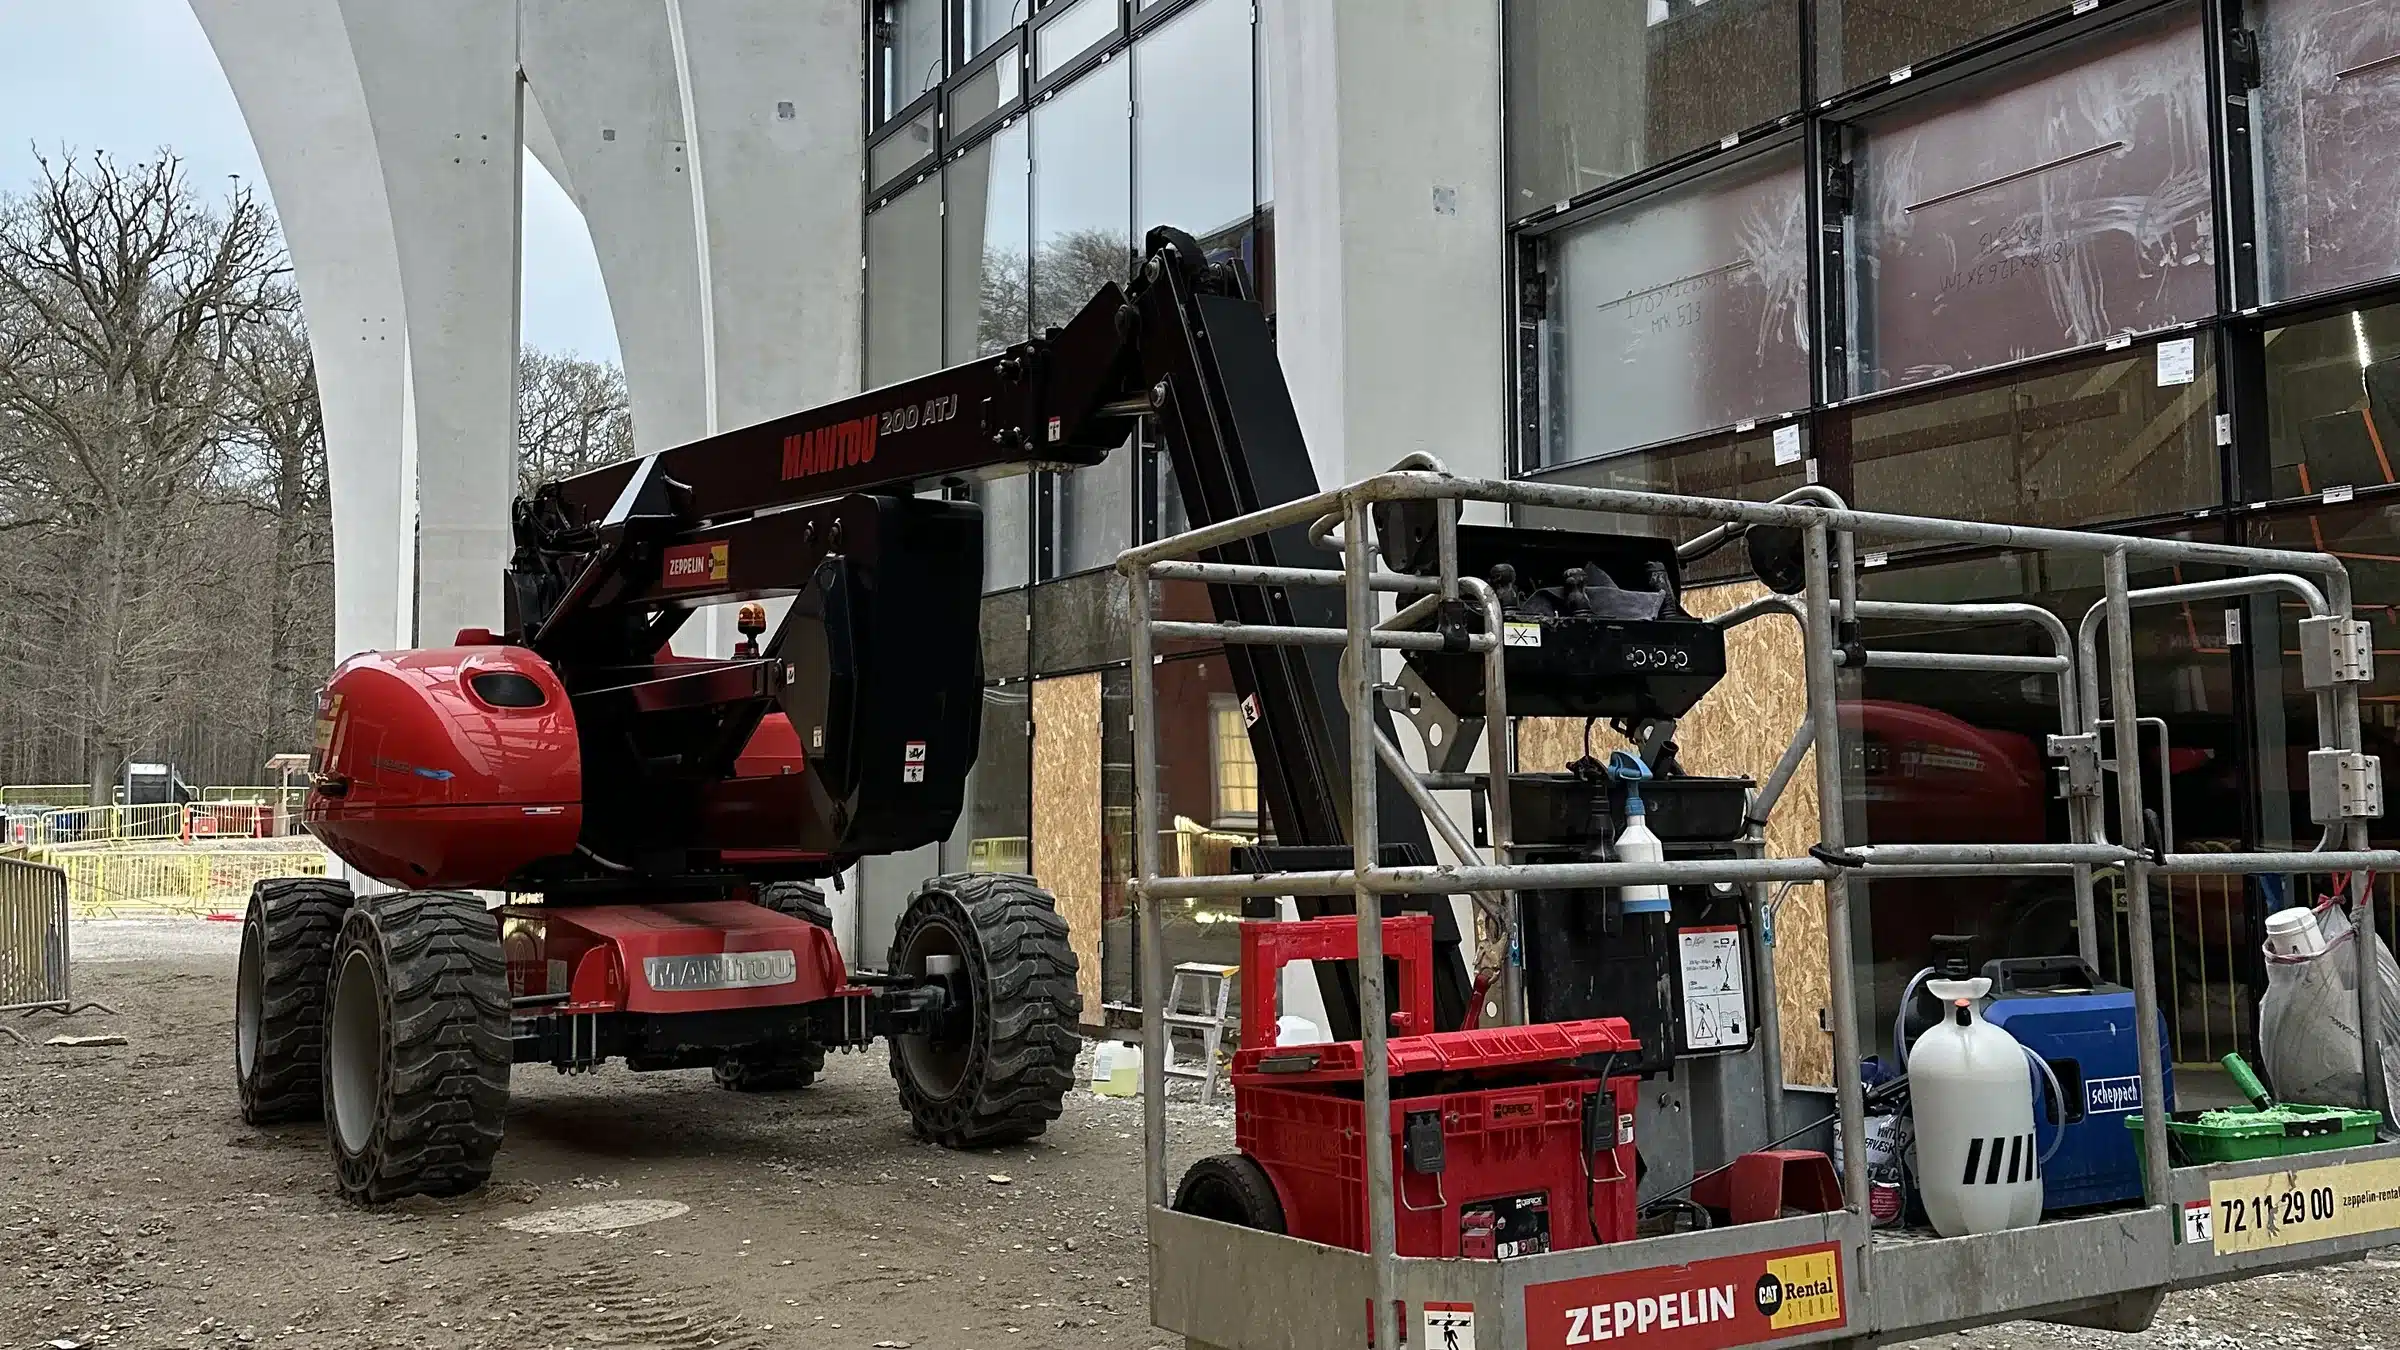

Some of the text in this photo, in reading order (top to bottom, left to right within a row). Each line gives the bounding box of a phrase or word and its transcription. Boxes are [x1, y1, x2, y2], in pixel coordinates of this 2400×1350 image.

[780, 393, 958, 481] MANITOU 200 ATJ
[669, 556, 705, 576] ZEPPELIN
[651, 957, 793, 986] MANITOU
[2092, 1078, 2138, 1110] scheppach
[2221, 1199, 2247, 1234] 72
[2281, 1191, 2306, 1225] 29
[2311, 1187, 2334, 1220] 00
[1759, 1276, 1834, 1305] CAT Rental
[1565, 1284, 1736, 1346] ZEPPELIN
